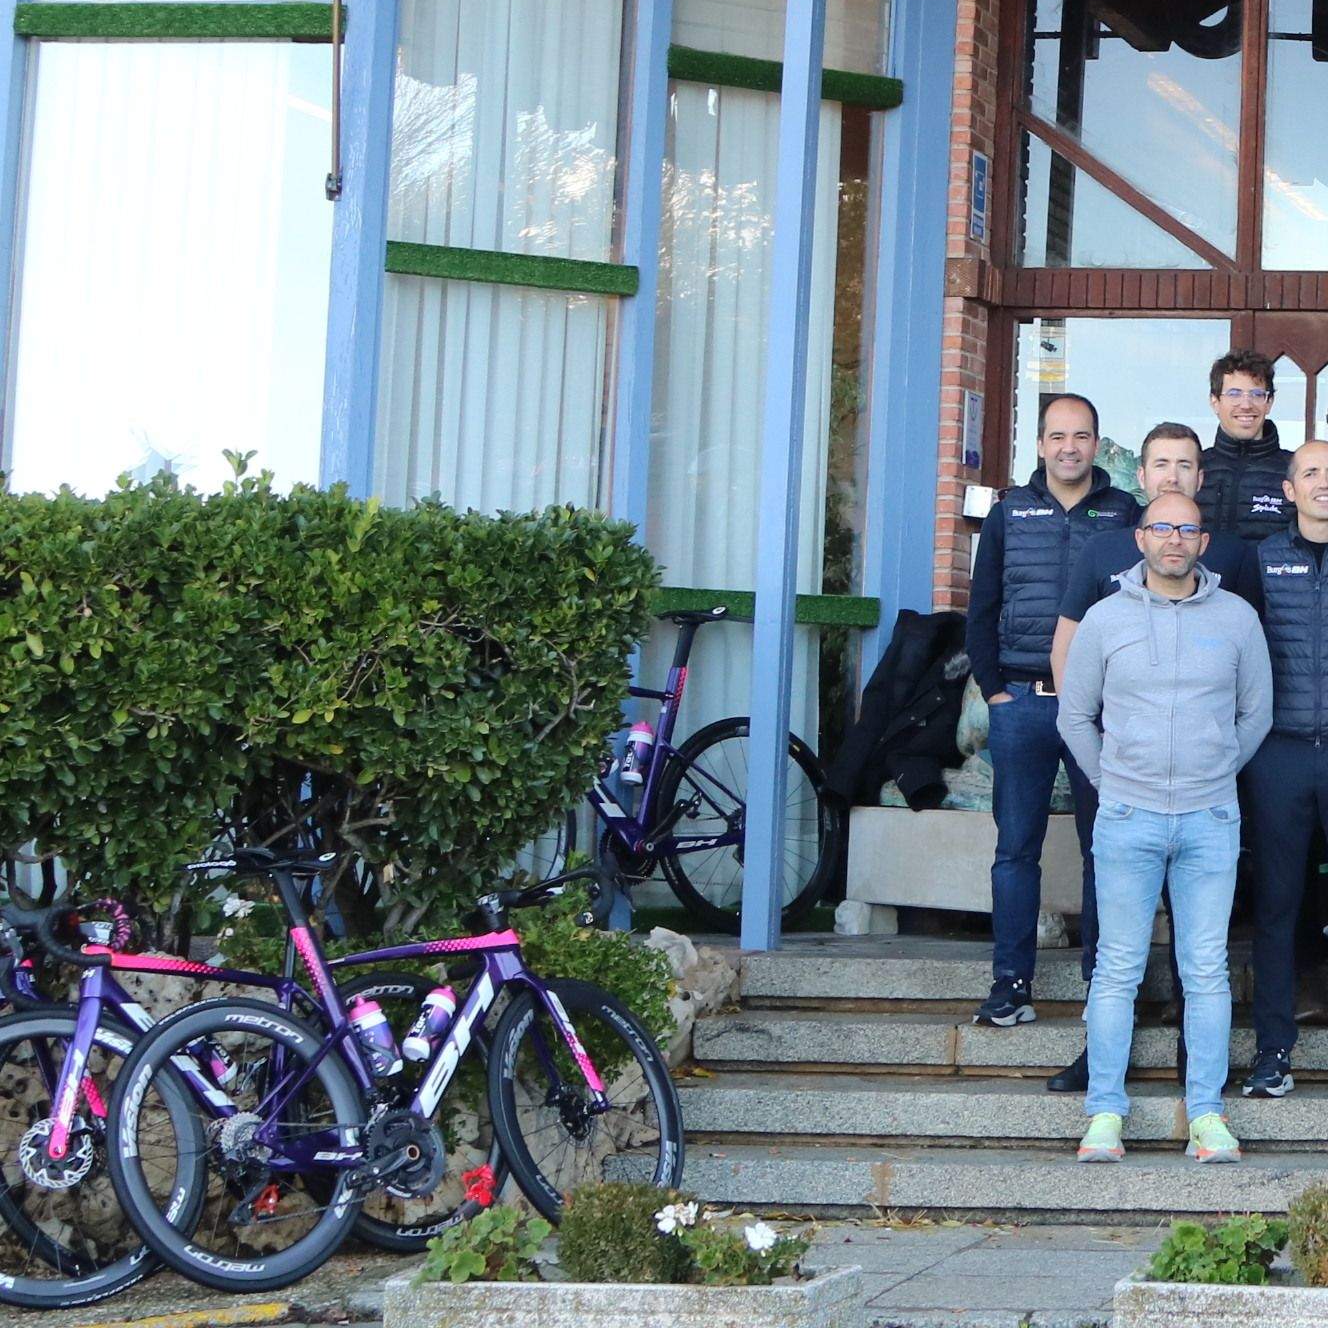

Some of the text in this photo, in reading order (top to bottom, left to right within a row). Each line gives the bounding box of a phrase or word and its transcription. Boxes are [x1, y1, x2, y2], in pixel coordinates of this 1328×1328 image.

[676, 838, 718, 850] BH
[225, 1013, 305, 1044] metron
[601, 1005, 654, 1063] metron
[418, 972, 495, 1119] BH
[314, 1151, 364, 1161] BH
[184, 1244, 265, 1273] metron
